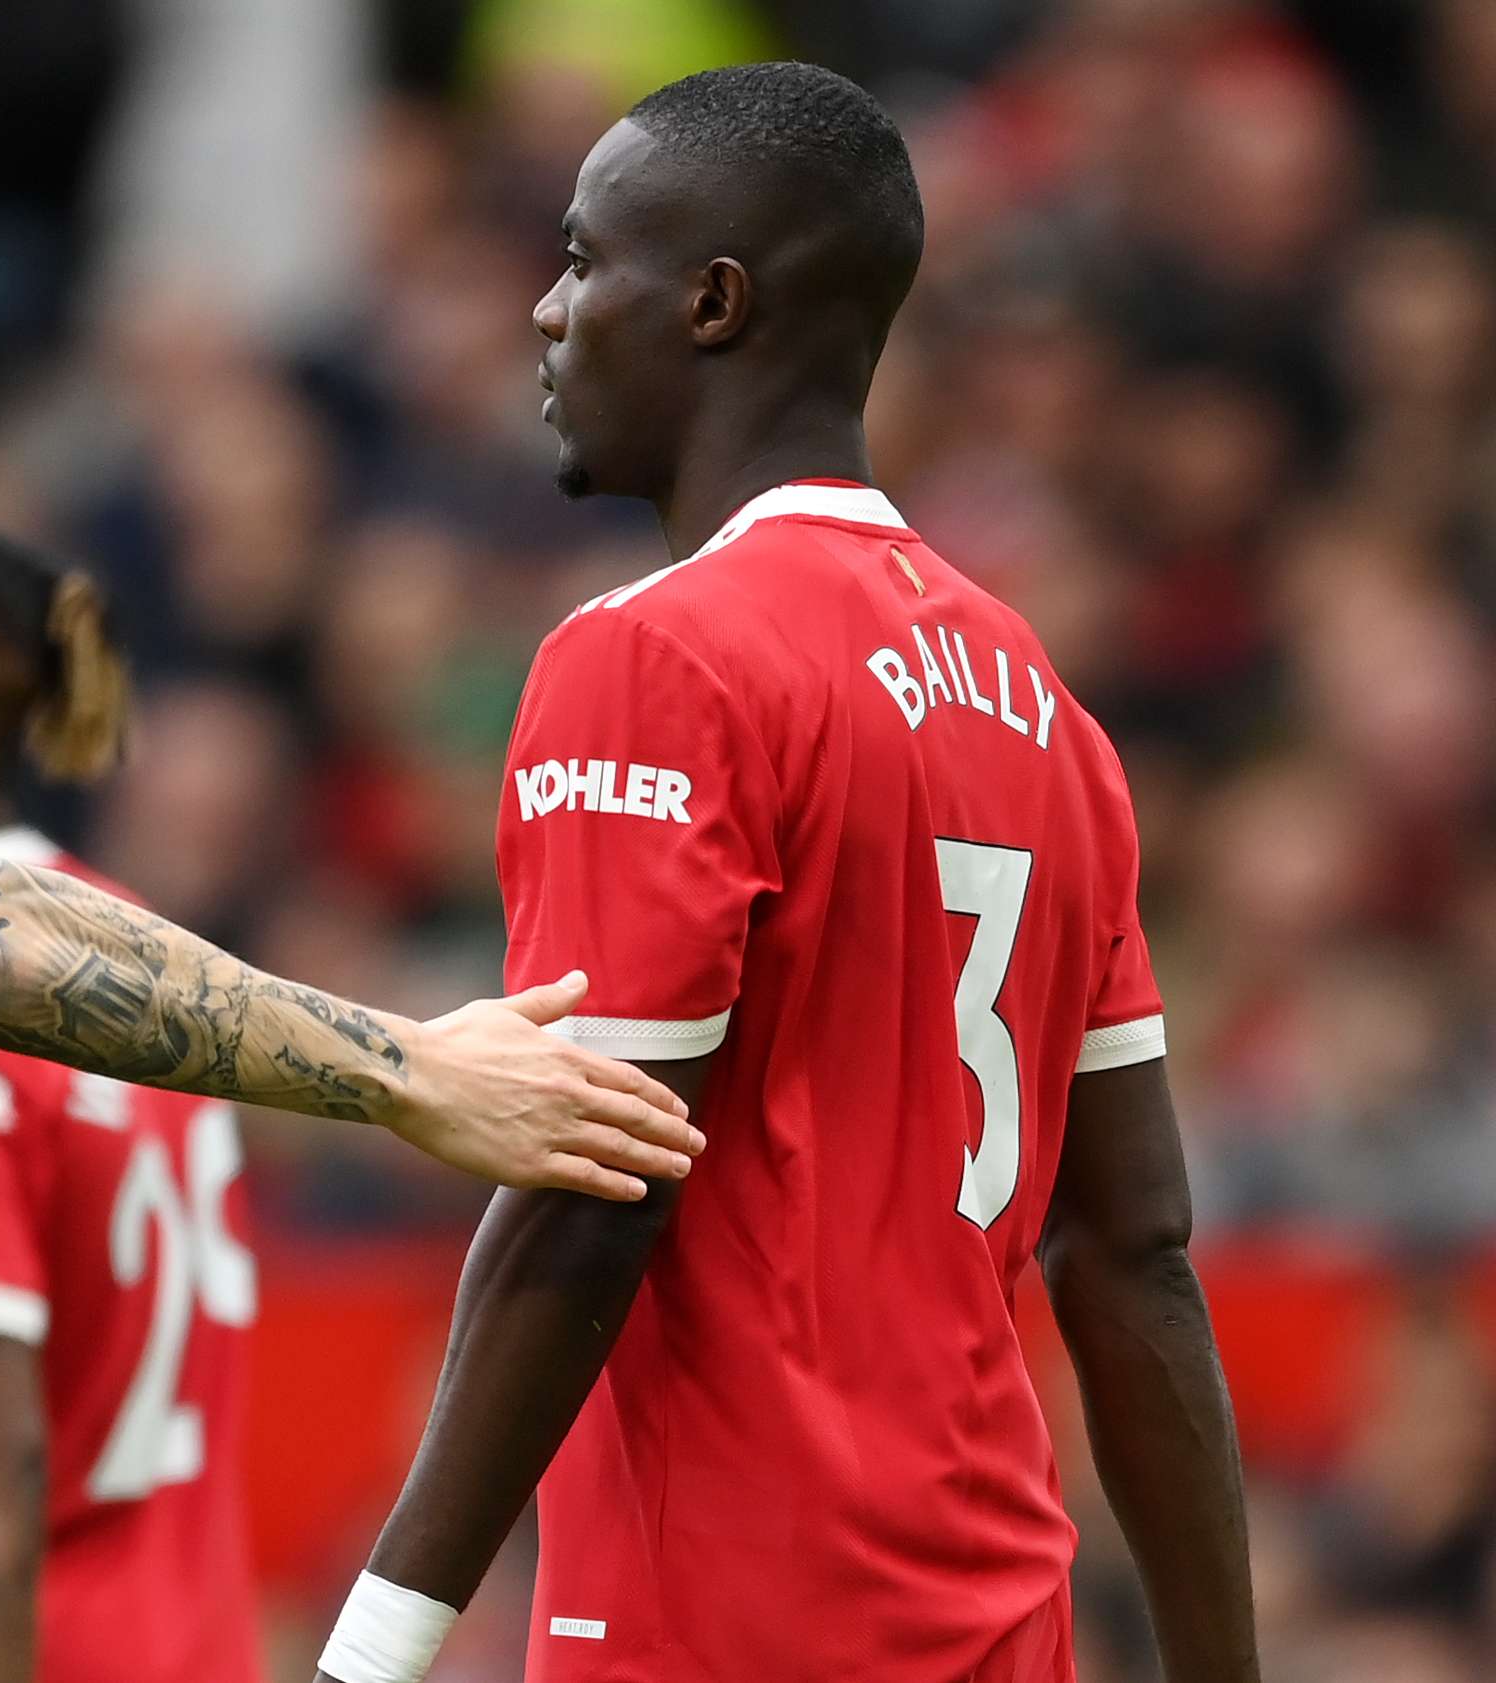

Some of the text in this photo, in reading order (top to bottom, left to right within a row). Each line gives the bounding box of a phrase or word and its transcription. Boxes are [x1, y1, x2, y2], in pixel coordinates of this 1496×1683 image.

[865, 623, 1056, 751] BAILLY
[513, 757, 693, 825] KOHLER
[933, 836, 1033, 1232] 3
